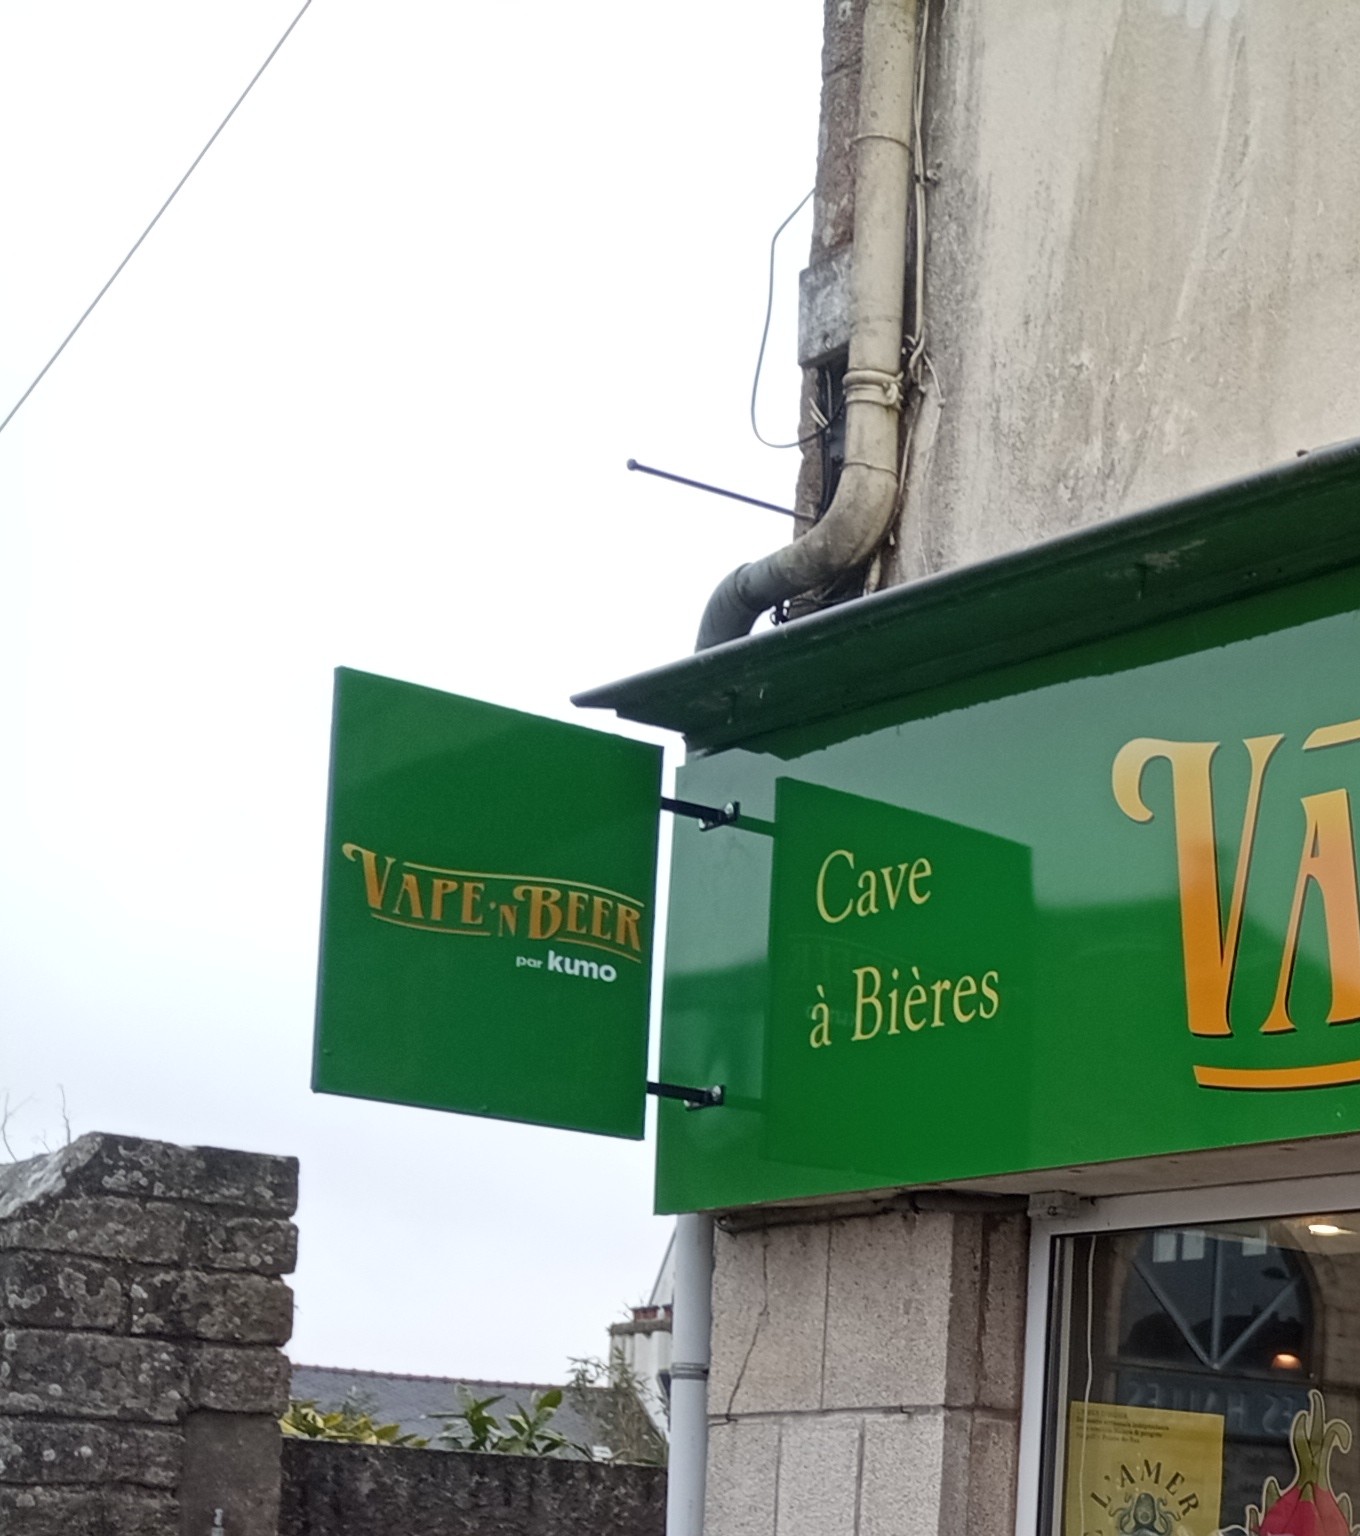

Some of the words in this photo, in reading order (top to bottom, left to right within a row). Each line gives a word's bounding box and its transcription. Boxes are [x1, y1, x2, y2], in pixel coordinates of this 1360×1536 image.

[342, 843, 485, 925] VAPE
[513, 885, 641, 952] BEER
[816, 849, 932, 924] Cave
[516, 954, 542, 969] par
[548, 950, 617, 983] kumo
[809, 985, 832, 1048] à
[852, 965, 1000, 1043] Bières
[1090, 1459, 1200, 1517] L'AMER
